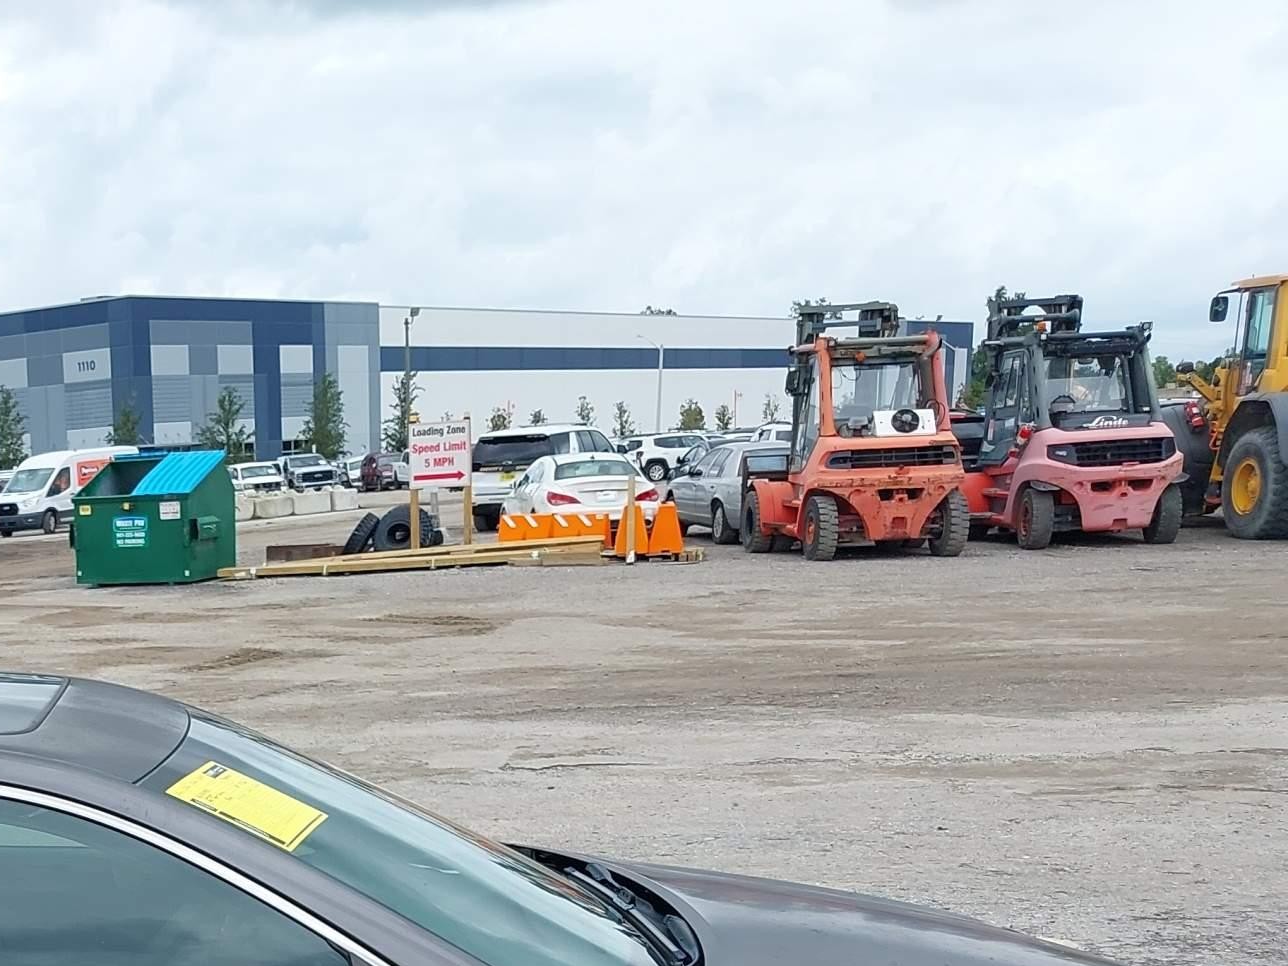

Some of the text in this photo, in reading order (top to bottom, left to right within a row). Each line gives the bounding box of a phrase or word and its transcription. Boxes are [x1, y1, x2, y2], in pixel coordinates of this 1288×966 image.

[77, 360, 96, 372] 1110
[412, 424, 466, 437] Loading Zone
[412, 440, 467, 455] Speed Limit
[424, 457, 454, 468] 5 MPH
